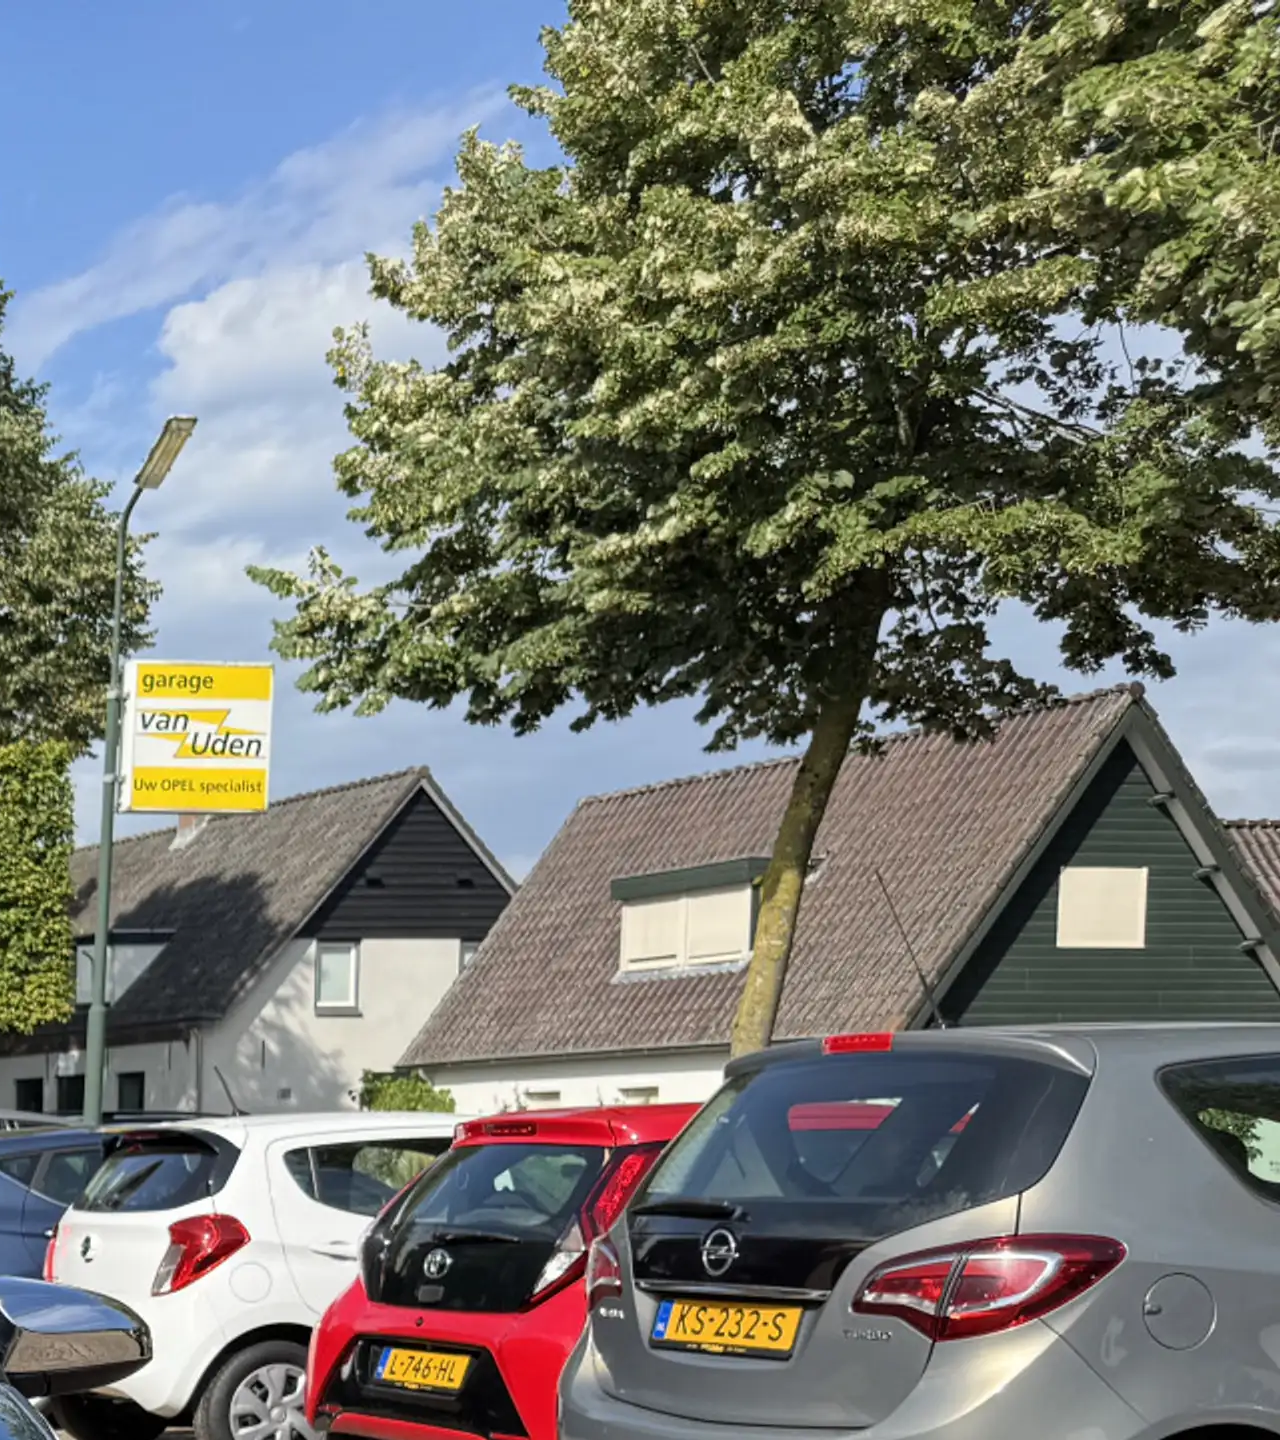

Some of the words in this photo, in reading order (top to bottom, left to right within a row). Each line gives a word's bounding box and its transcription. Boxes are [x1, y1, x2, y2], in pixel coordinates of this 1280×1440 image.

[142, 674, 214, 693] garage
[141, 712, 190, 732] van
[191, 732, 262, 757] Uden
[134, 779, 157, 791] Uw
[161, 779, 195, 792] OPEL
[200, 779, 262, 795] specialist
[675, 1304, 787, 1342] KS-232-S
[388, 1354, 456, 1382] L-746-HL
